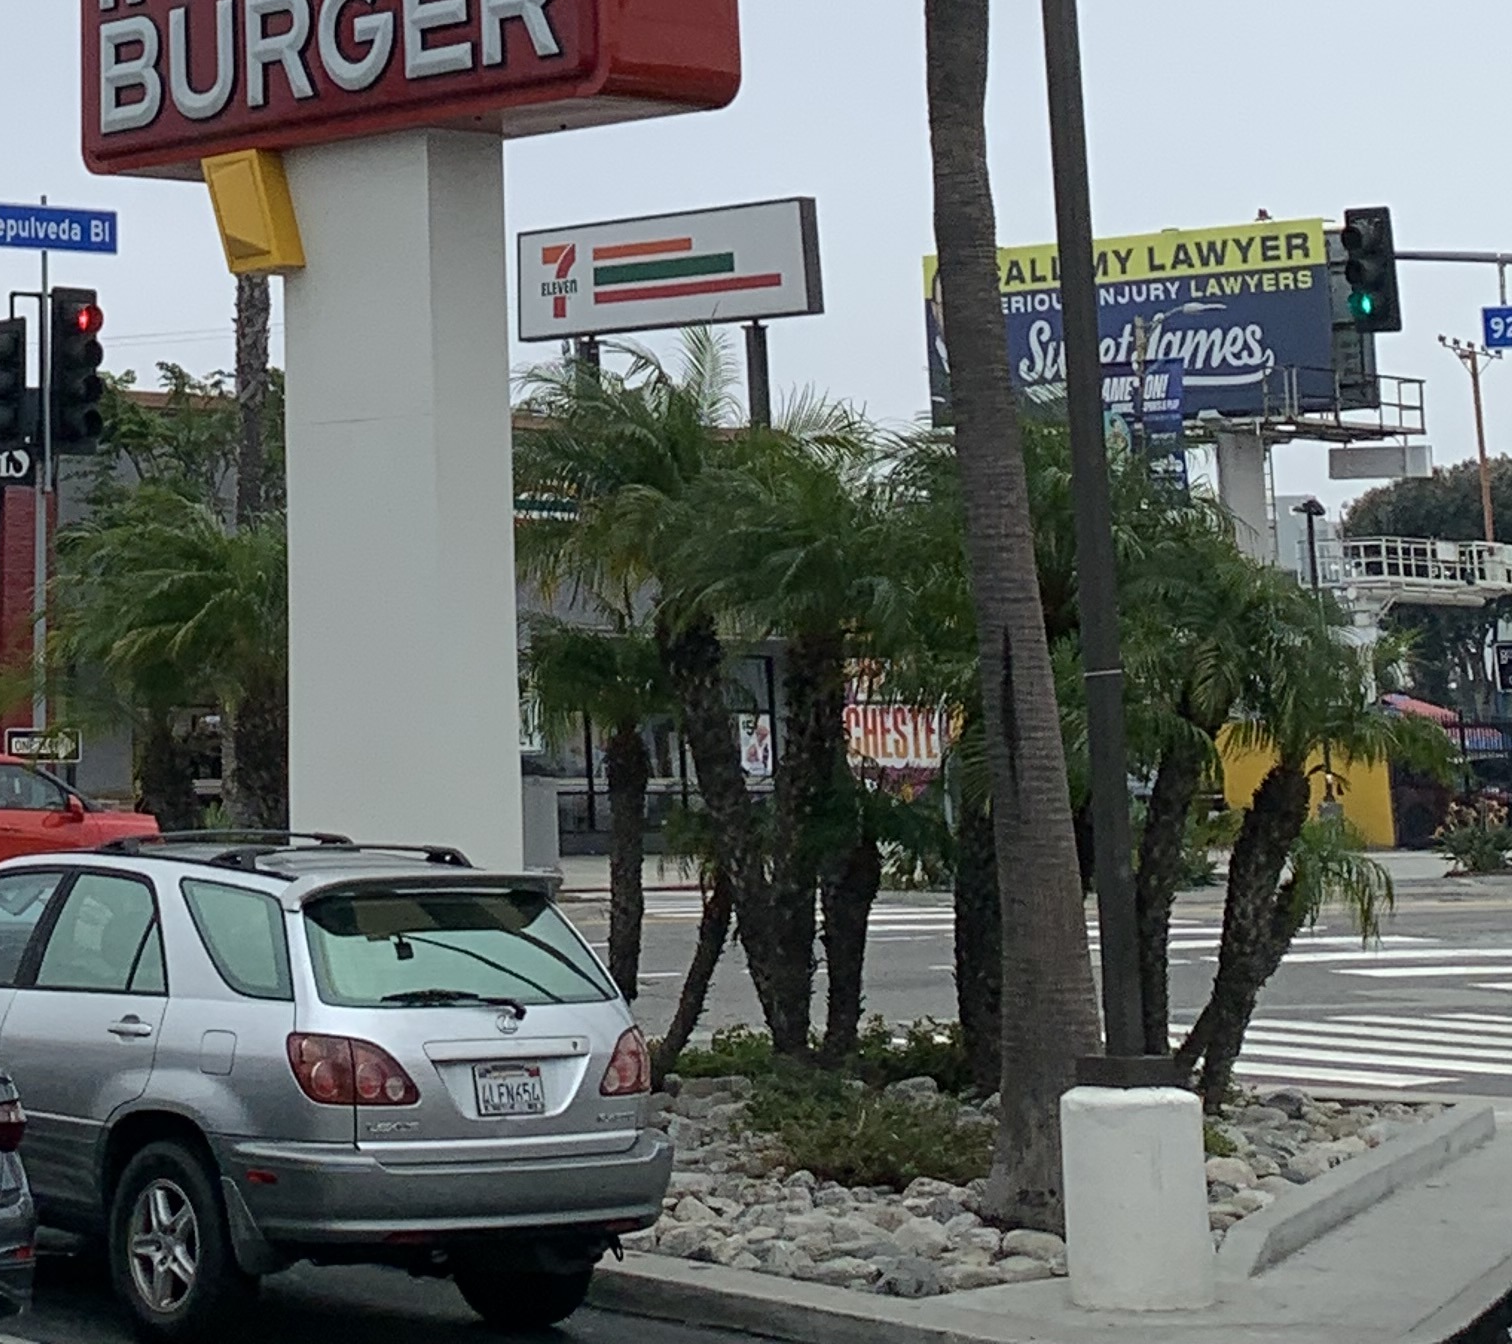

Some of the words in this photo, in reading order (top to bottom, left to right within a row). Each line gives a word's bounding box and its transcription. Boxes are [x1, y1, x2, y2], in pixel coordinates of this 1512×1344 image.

[90, 219, 110, 243] Bl
[998, 256, 1061, 287] ALL
[1147, 231, 1311, 271] LAWYER
[1001, 292, 1062, 315] ERIOU
[1099, 279, 1180, 307] NJURY
[1189, 269, 1314, 298] LAWYERS
[1101, 375, 1139, 403] AME
